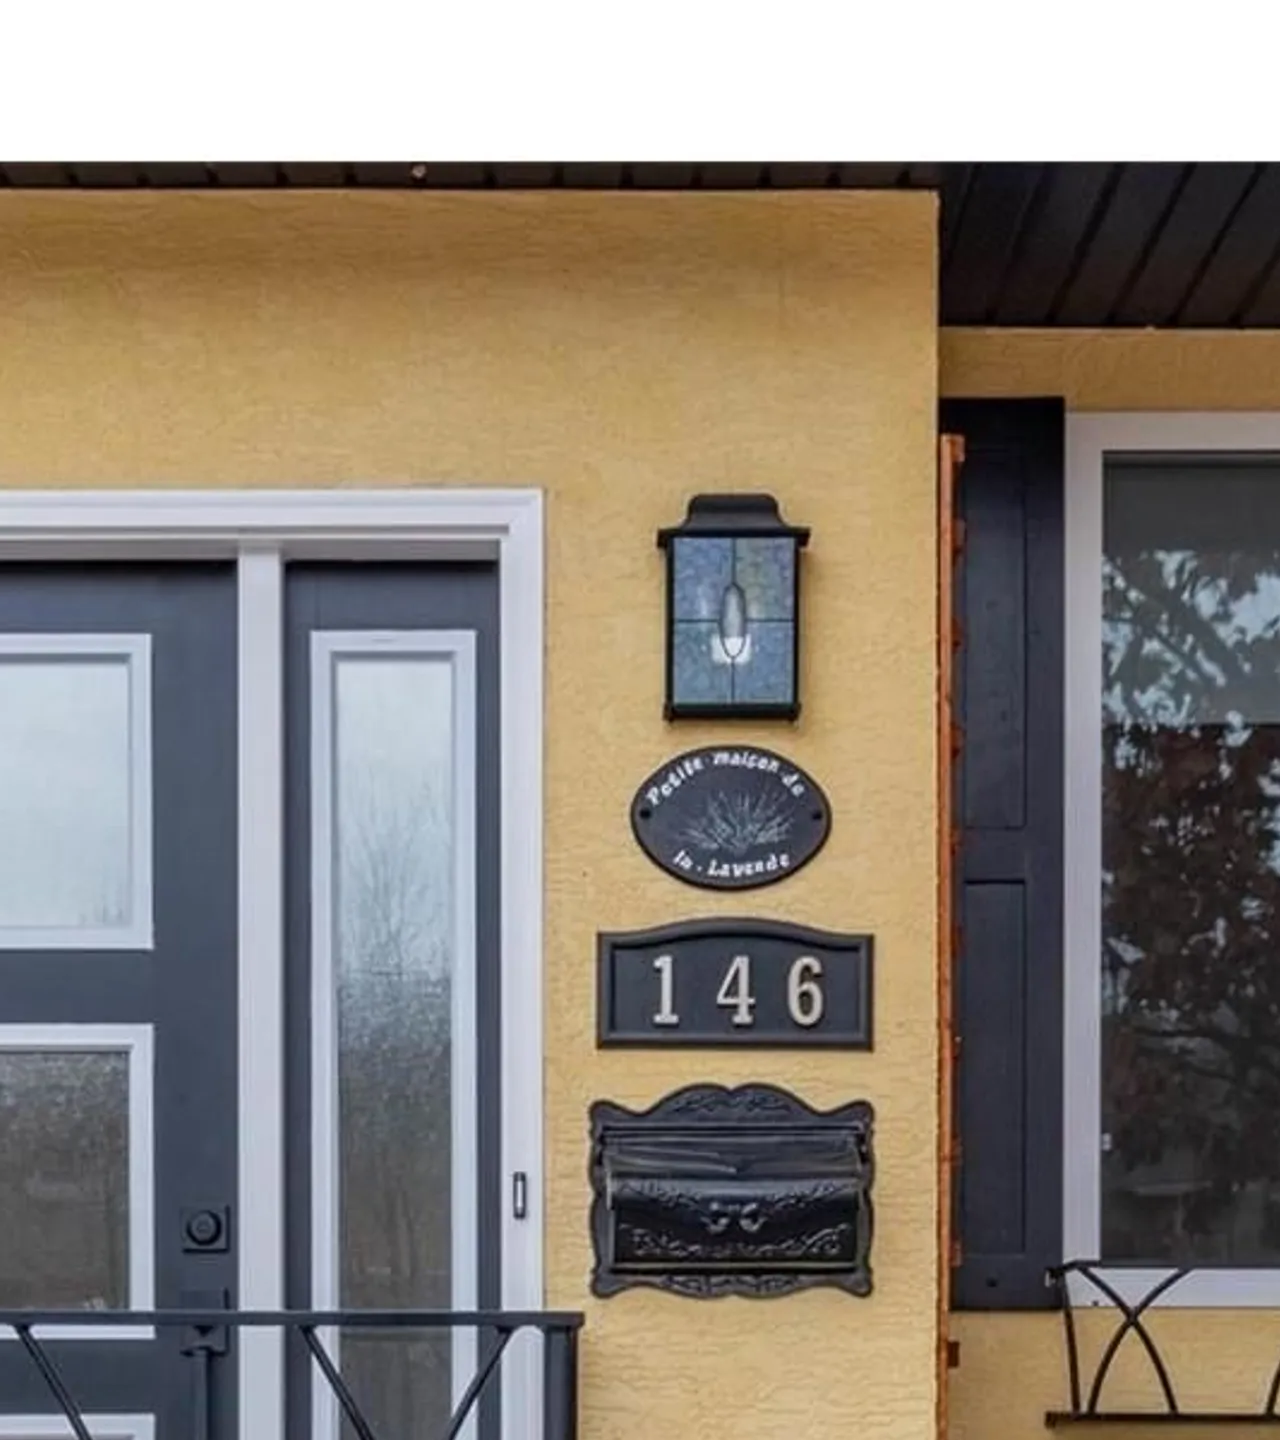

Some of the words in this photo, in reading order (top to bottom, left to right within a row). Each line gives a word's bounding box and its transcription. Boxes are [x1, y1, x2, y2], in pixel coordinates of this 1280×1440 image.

[645, 758, 704, 806] Petite
[782, 773, 805, 797] de
[653, 955, 824, 1026] 146
